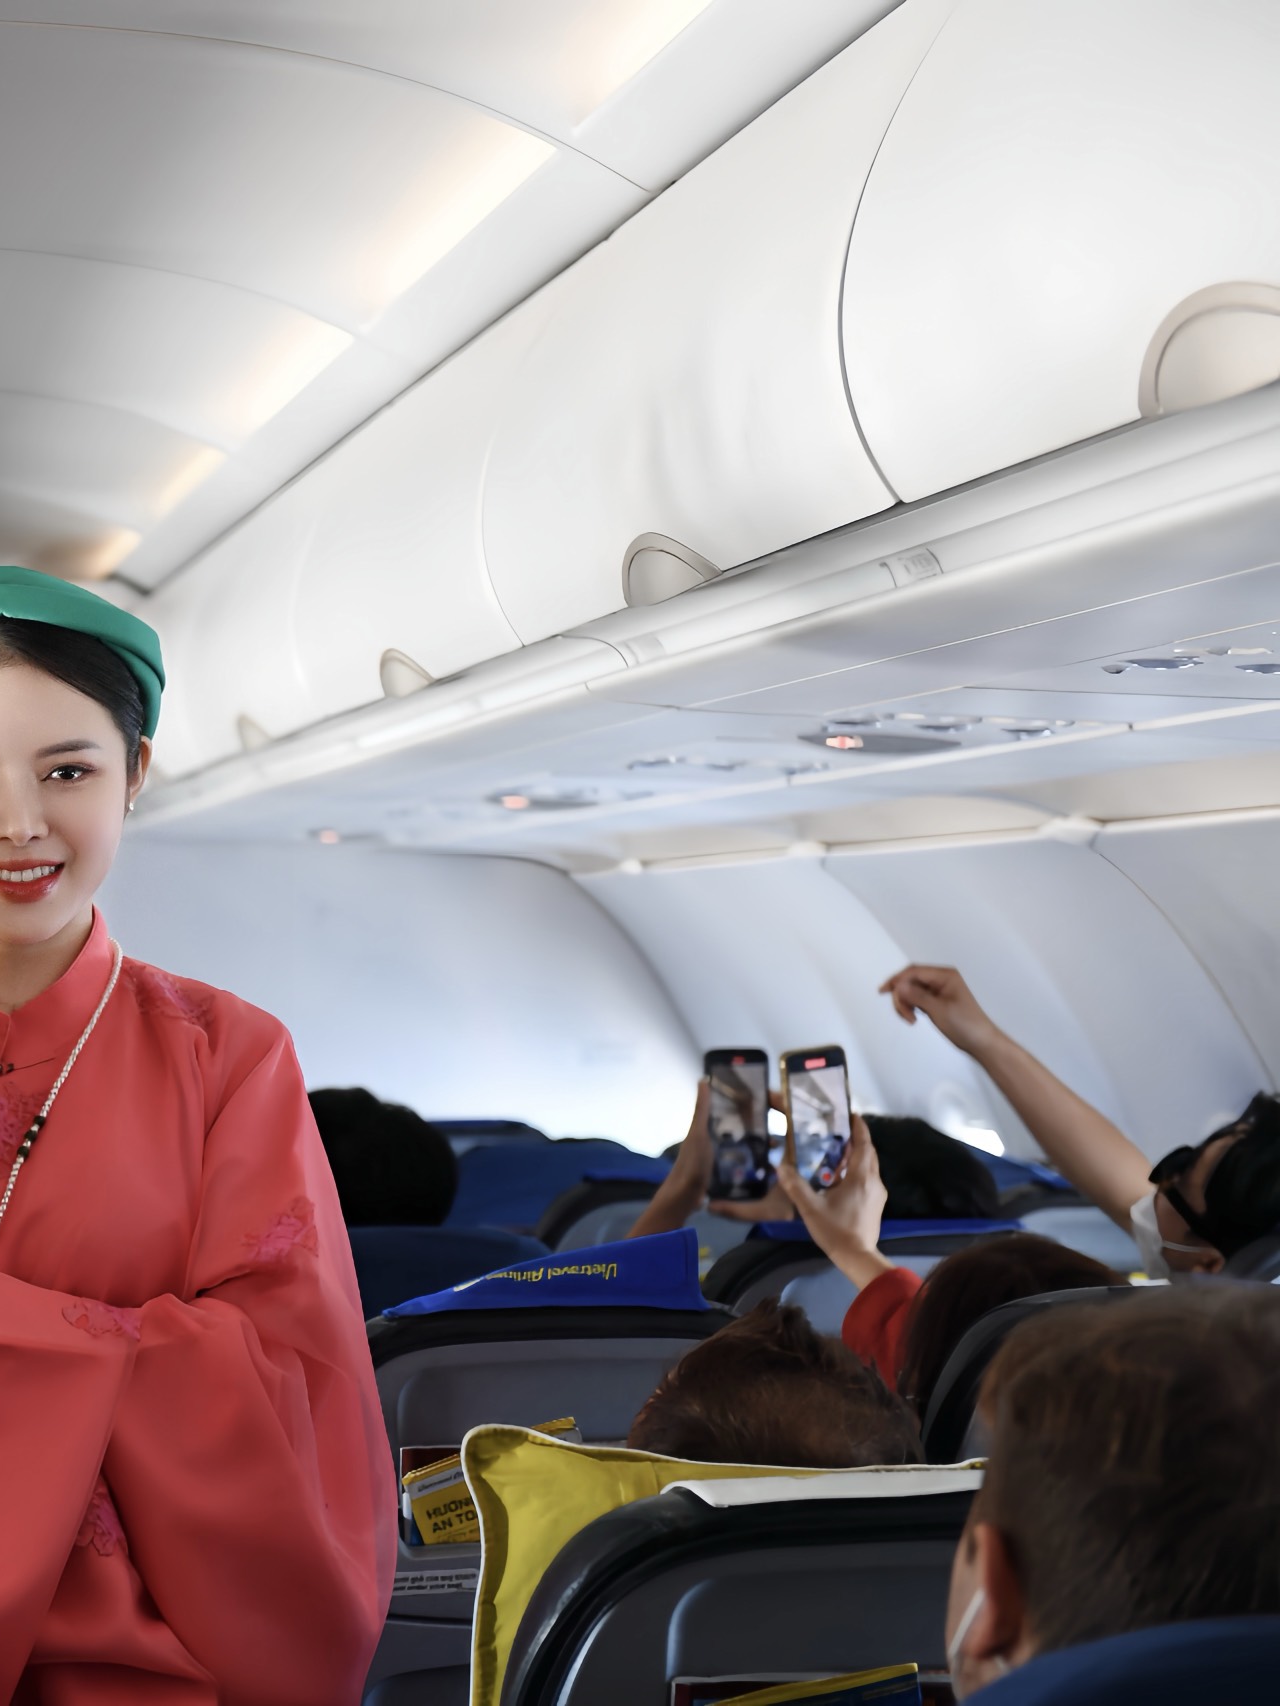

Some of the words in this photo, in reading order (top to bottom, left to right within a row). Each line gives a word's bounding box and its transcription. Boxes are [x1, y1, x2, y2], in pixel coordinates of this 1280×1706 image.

[485, 1267, 544, 1282] Airlin
[547, 1263, 617, 1280] Vietravel
[432, 1517, 453, 1533] AN
[456, 1510, 478, 1524] TO
